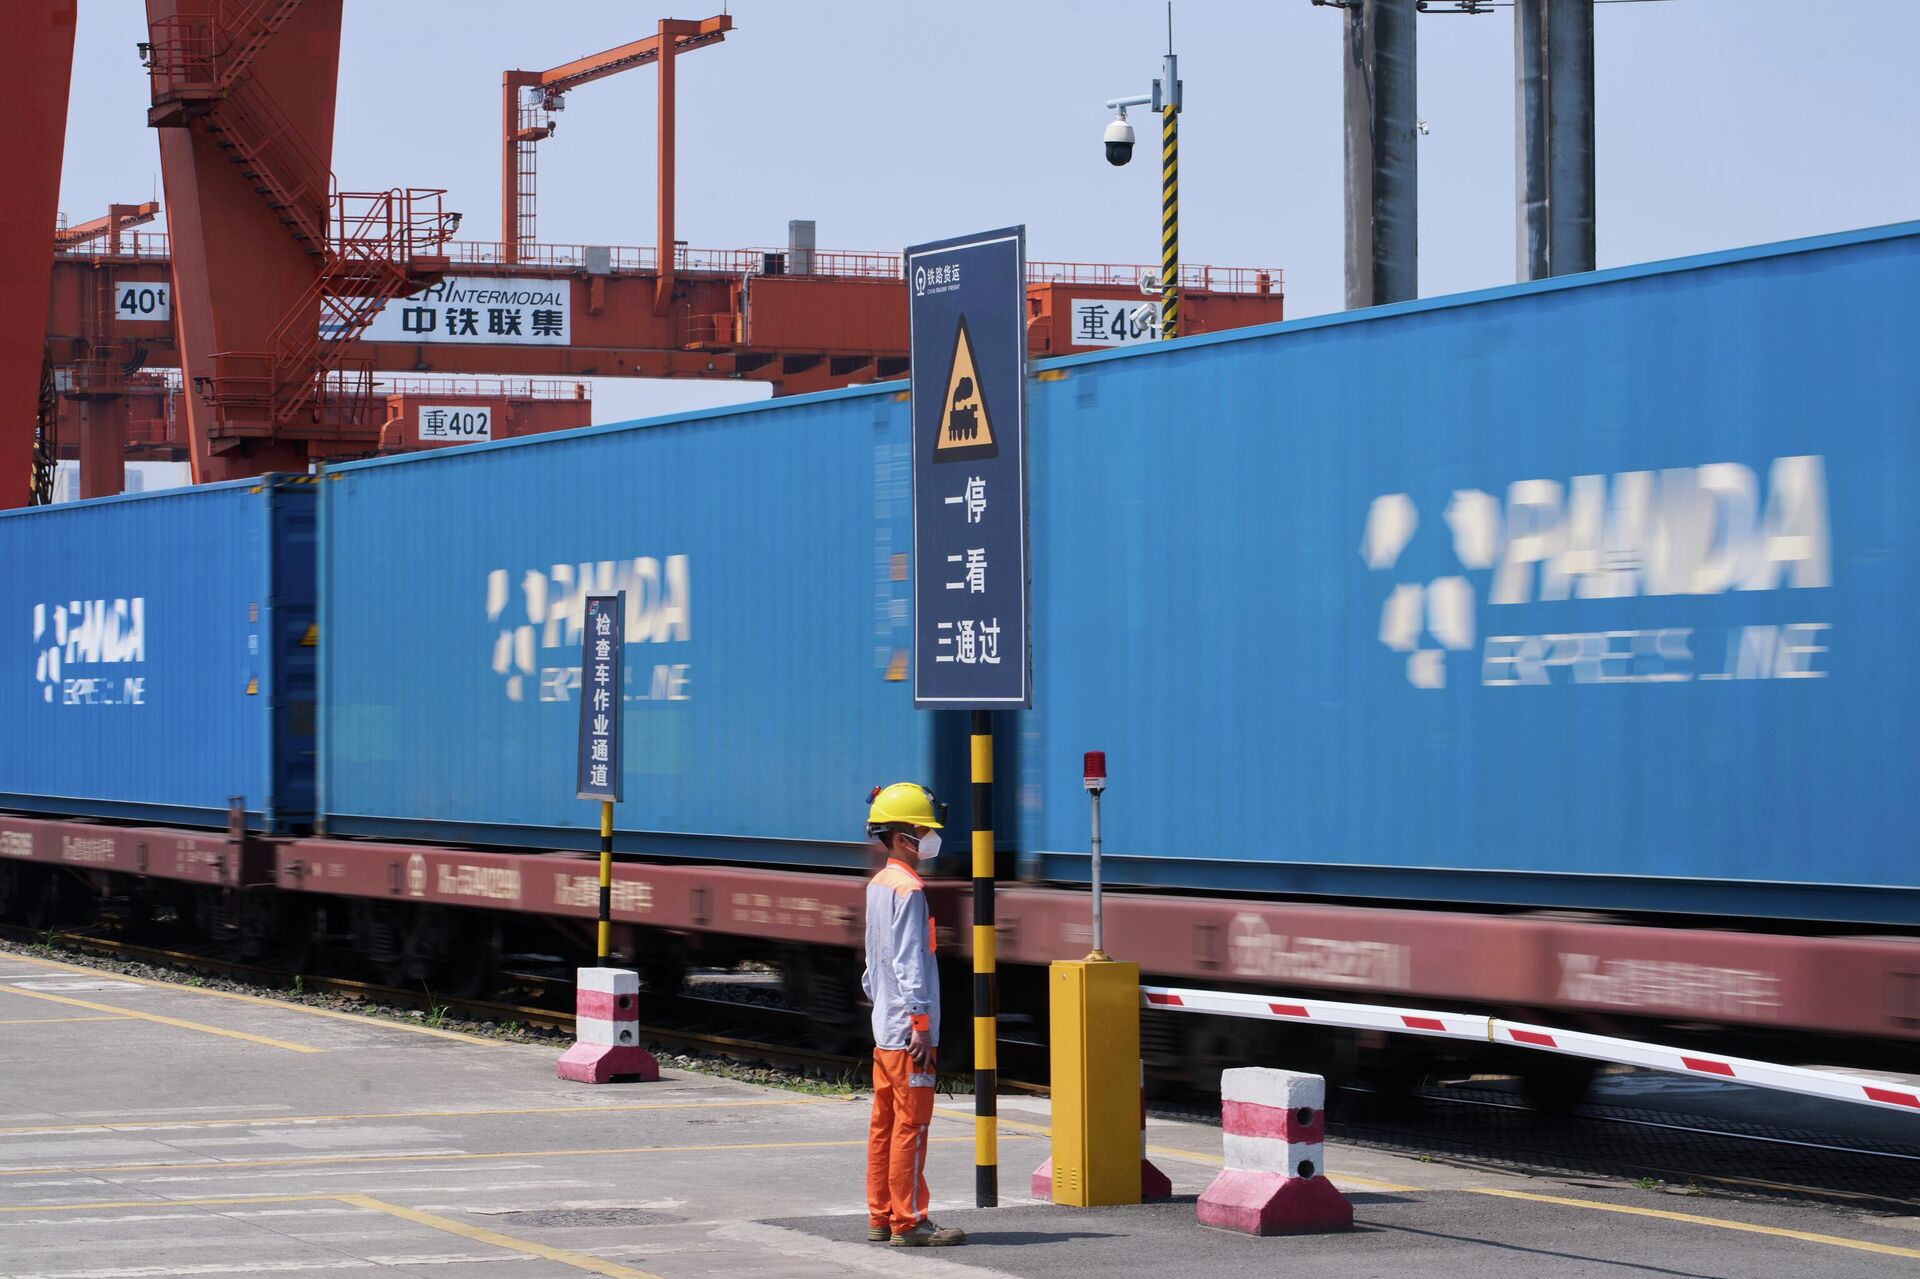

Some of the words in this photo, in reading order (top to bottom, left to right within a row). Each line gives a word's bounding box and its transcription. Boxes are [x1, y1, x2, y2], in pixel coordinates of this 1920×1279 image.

[927, 264, 960, 286] 铁路货运
[402, 306, 564, 337] 中铁联集
[423, 409, 489, 437] 重402
[944, 475, 987, 523] 一停
[945, 547, 988, 594] 二看
[935, 617, 1001, 665] 三通过
[590, 612, 612, 787] 检查车作业通道
